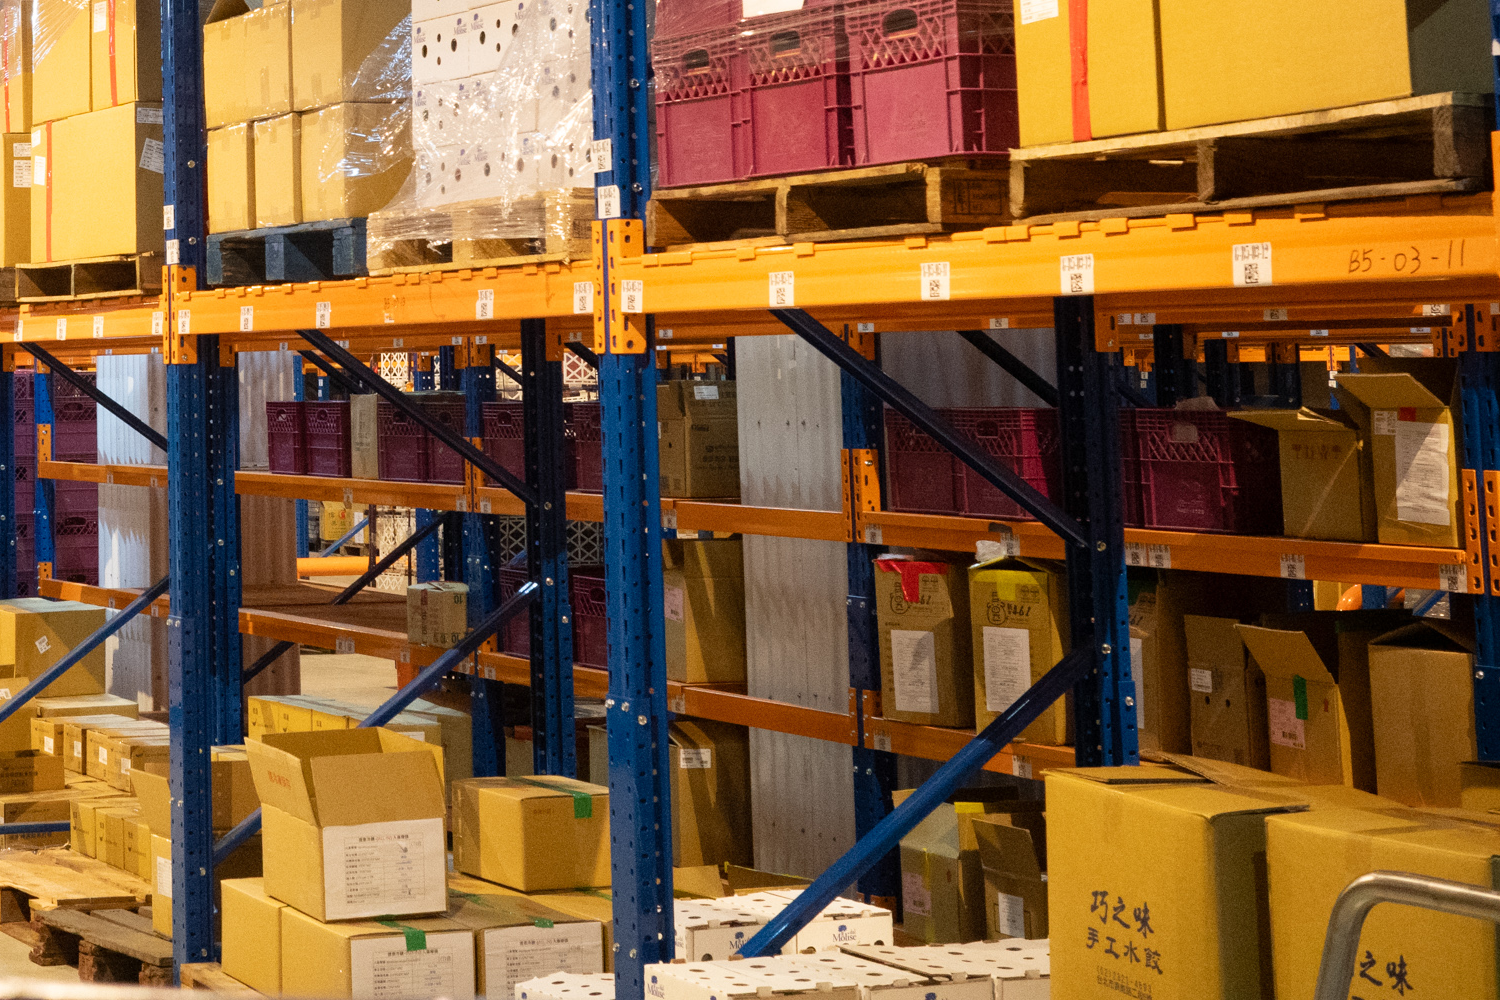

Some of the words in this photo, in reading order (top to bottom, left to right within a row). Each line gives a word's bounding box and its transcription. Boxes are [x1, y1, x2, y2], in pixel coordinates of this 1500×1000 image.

[833, 931, 857, 942] Molise
[1090, 890, 1155, 939] 巧之味
[1086, 926, 1164, 975] 手工水餃
[1359, 950, 1414, 997] 之味
